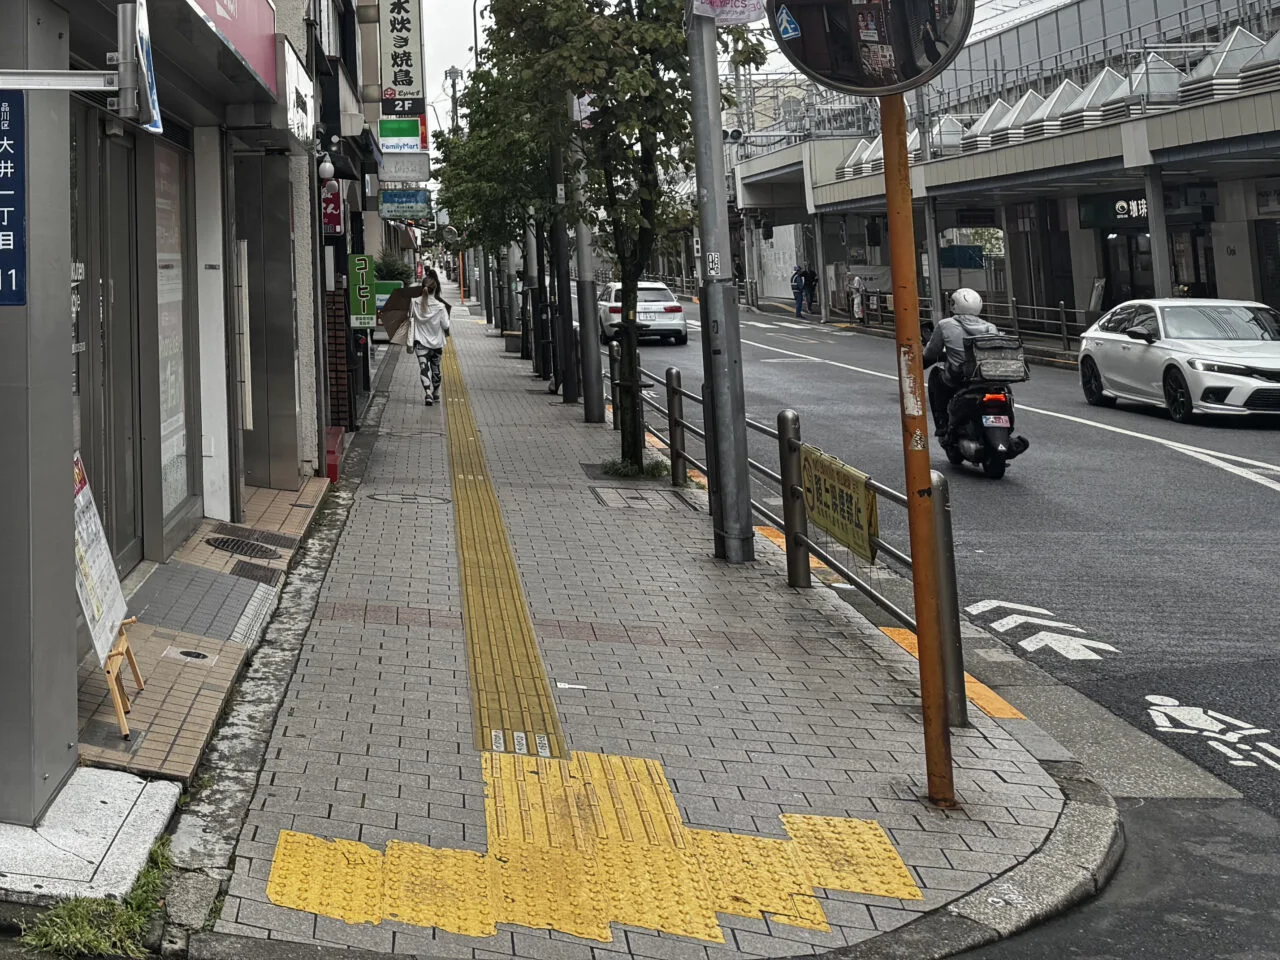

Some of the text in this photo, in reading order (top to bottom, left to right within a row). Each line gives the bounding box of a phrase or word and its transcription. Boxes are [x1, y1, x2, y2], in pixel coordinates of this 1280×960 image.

[1, 103, 10, 130] 品川区
[395, 101, 413, 111] 2F
[356, 256, 369, 314] コーヒー
